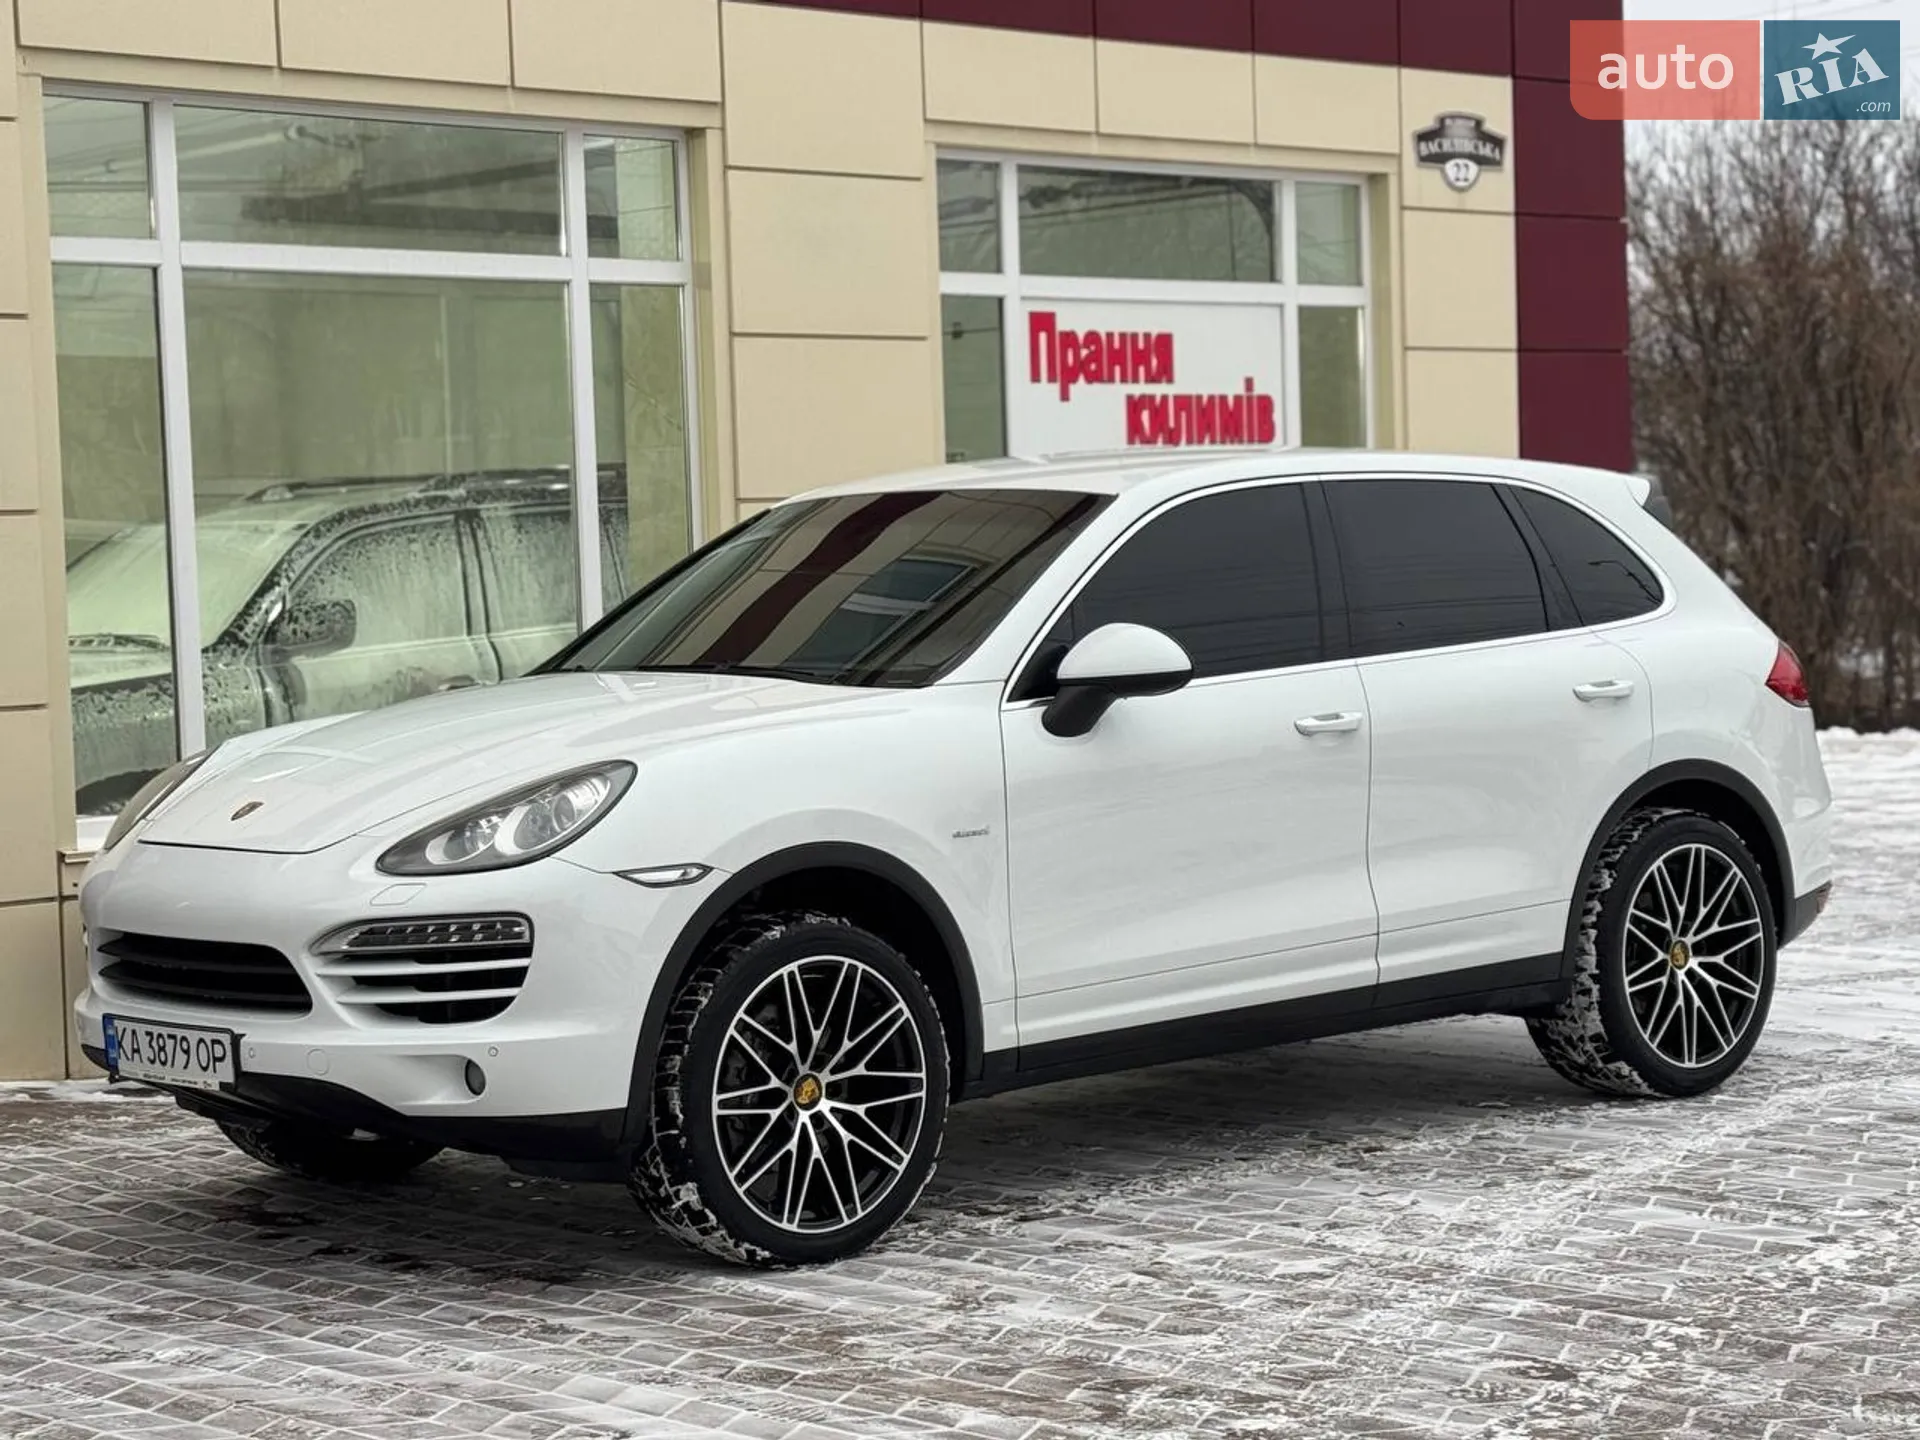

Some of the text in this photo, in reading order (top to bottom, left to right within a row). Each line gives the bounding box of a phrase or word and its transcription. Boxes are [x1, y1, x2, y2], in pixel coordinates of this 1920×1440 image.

[1453, 162, 1470, 182] 22
[1029, 311, 1174, 402] Прання
[1126, 376, 1276, 446] килимів
[115, 1026, 227, 1074] KA 3879 OP
